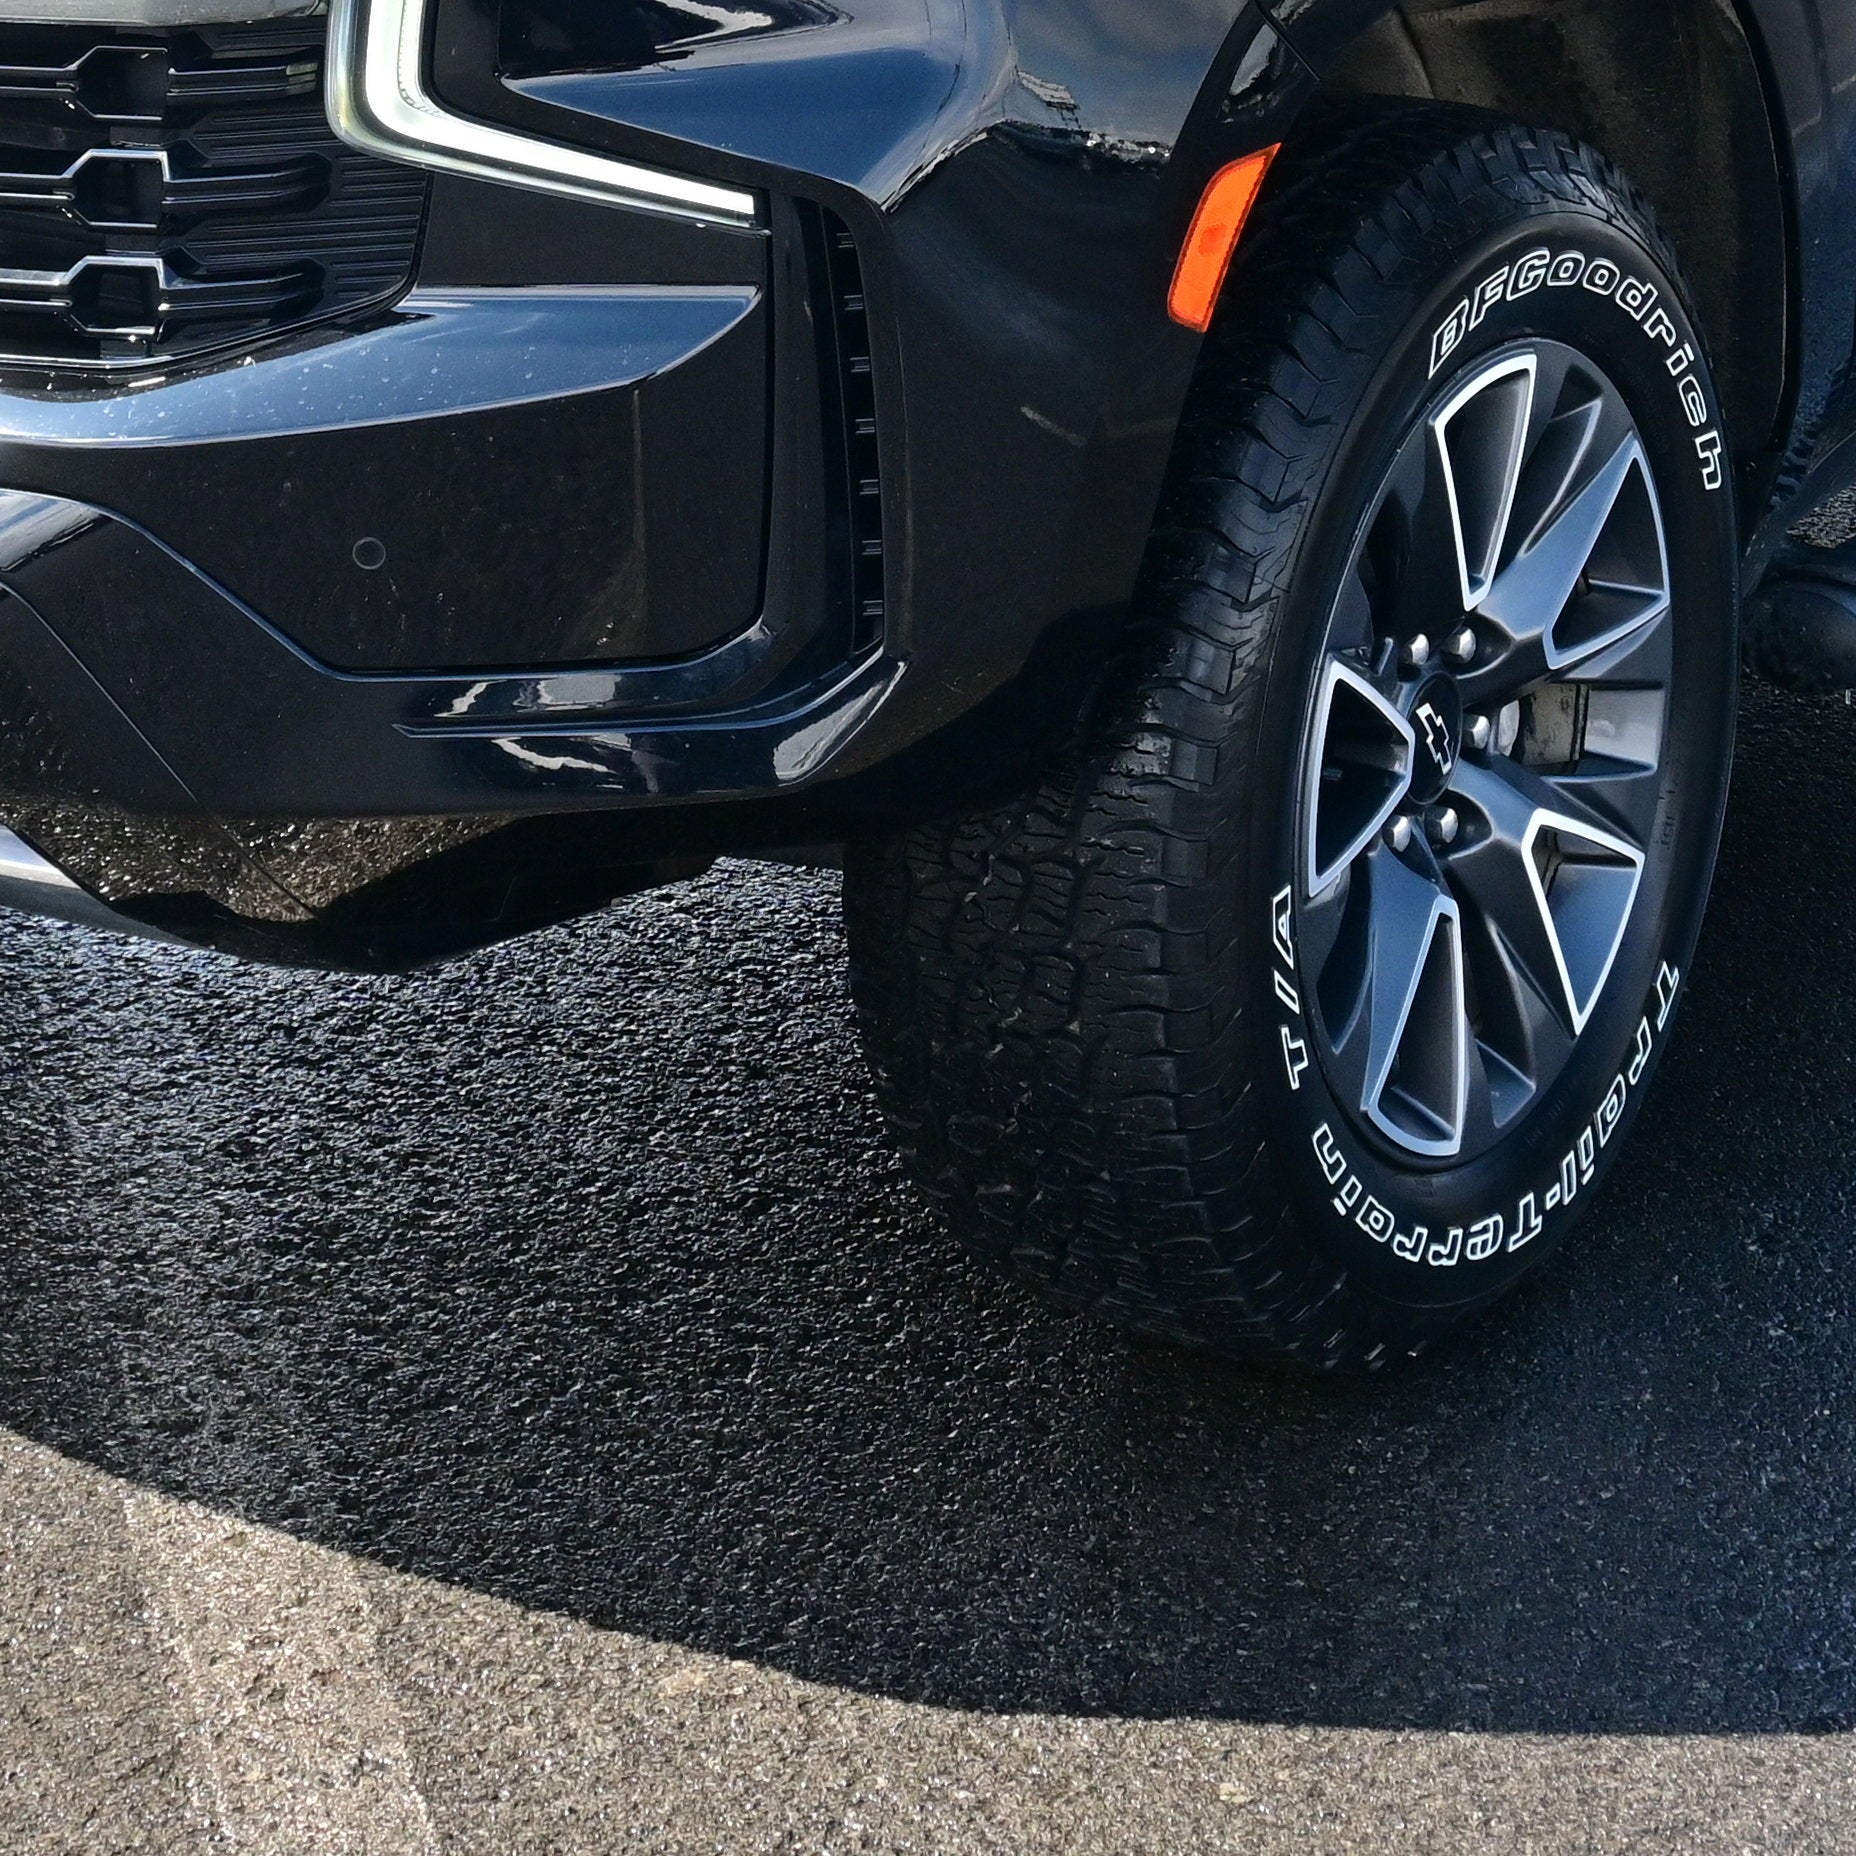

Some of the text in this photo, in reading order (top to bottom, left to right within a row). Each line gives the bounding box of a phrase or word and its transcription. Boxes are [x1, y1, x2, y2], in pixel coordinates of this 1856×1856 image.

[1427, 246, 1723, 491] BFGoodrich
[1271, 884, 1681, 1267] Trail-Terrain T/A
